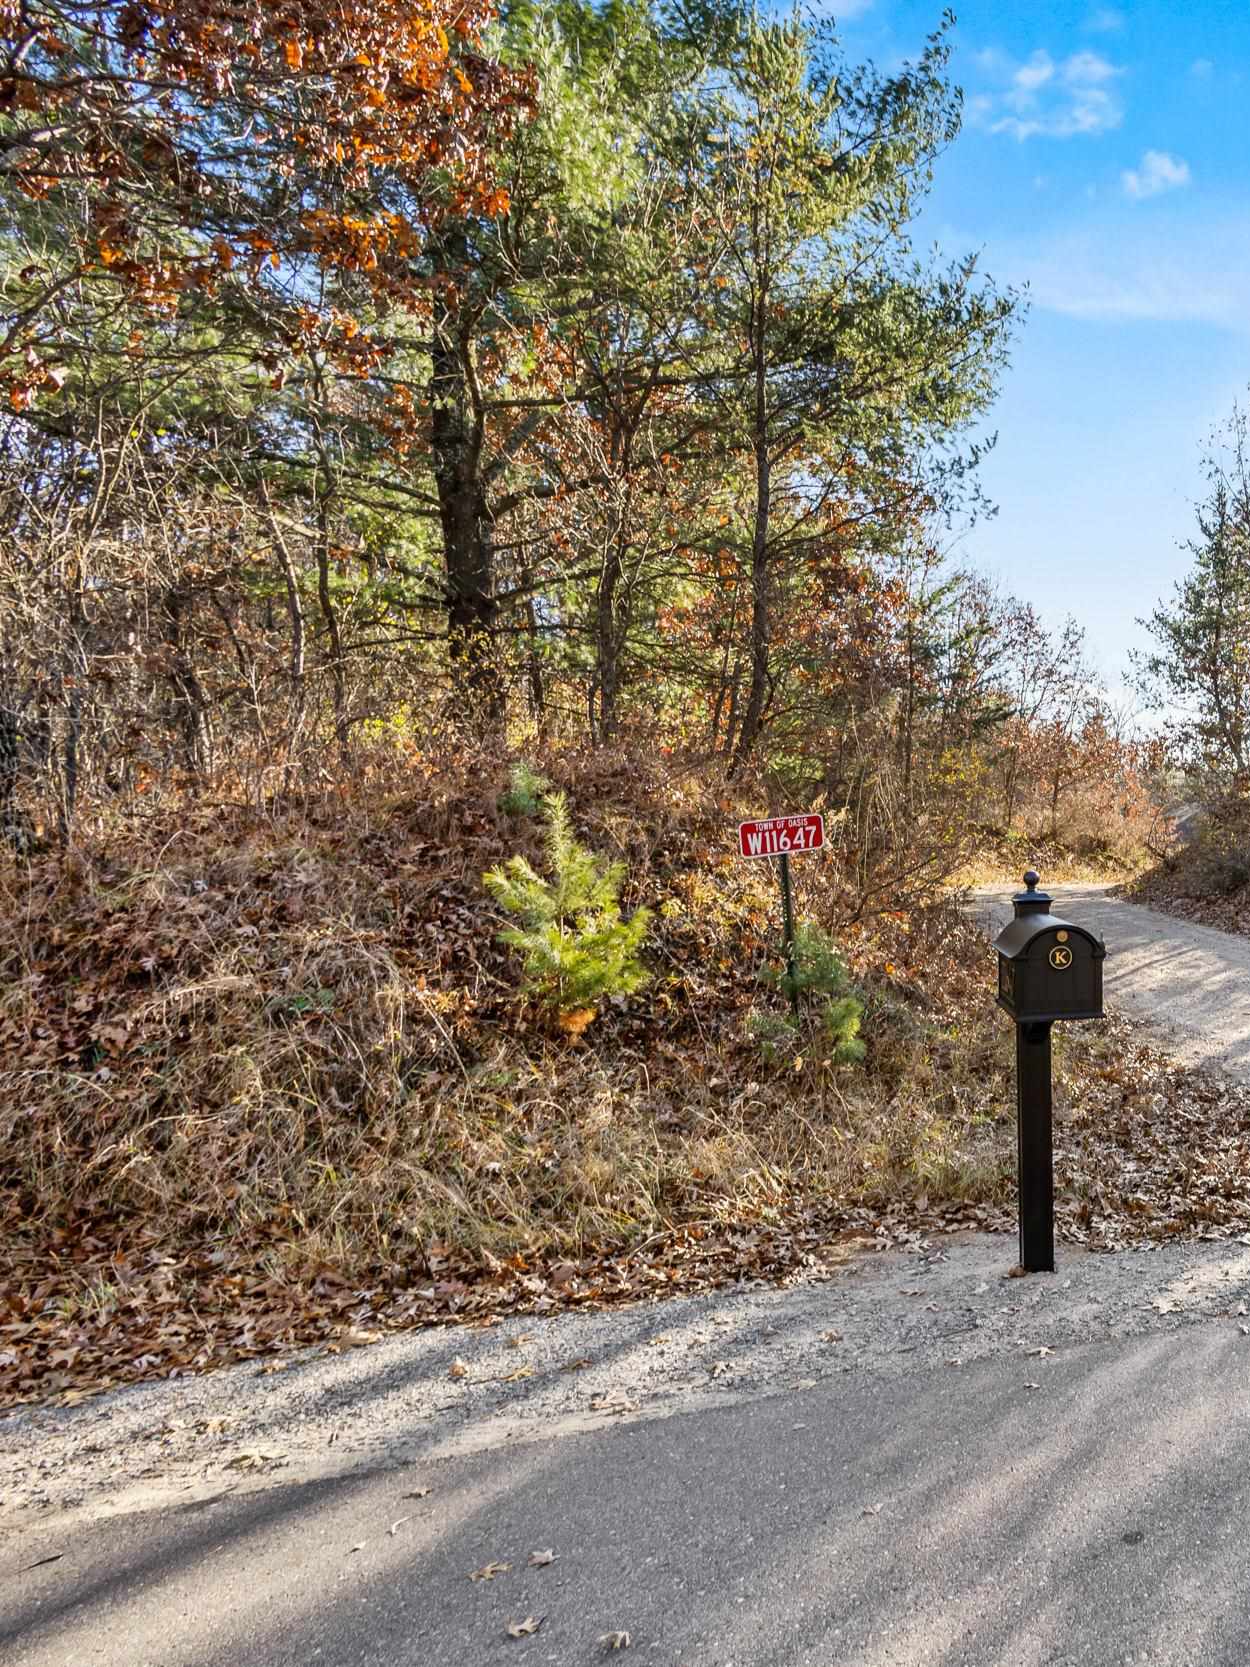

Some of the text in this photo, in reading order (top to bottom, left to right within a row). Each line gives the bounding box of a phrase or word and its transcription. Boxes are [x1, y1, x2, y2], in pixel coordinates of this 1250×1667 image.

[755, 818, 808, 832] TOWN OF OASIS
[747, 825, 817, 855] W11647
[1054, 951, 1068, 964] K
